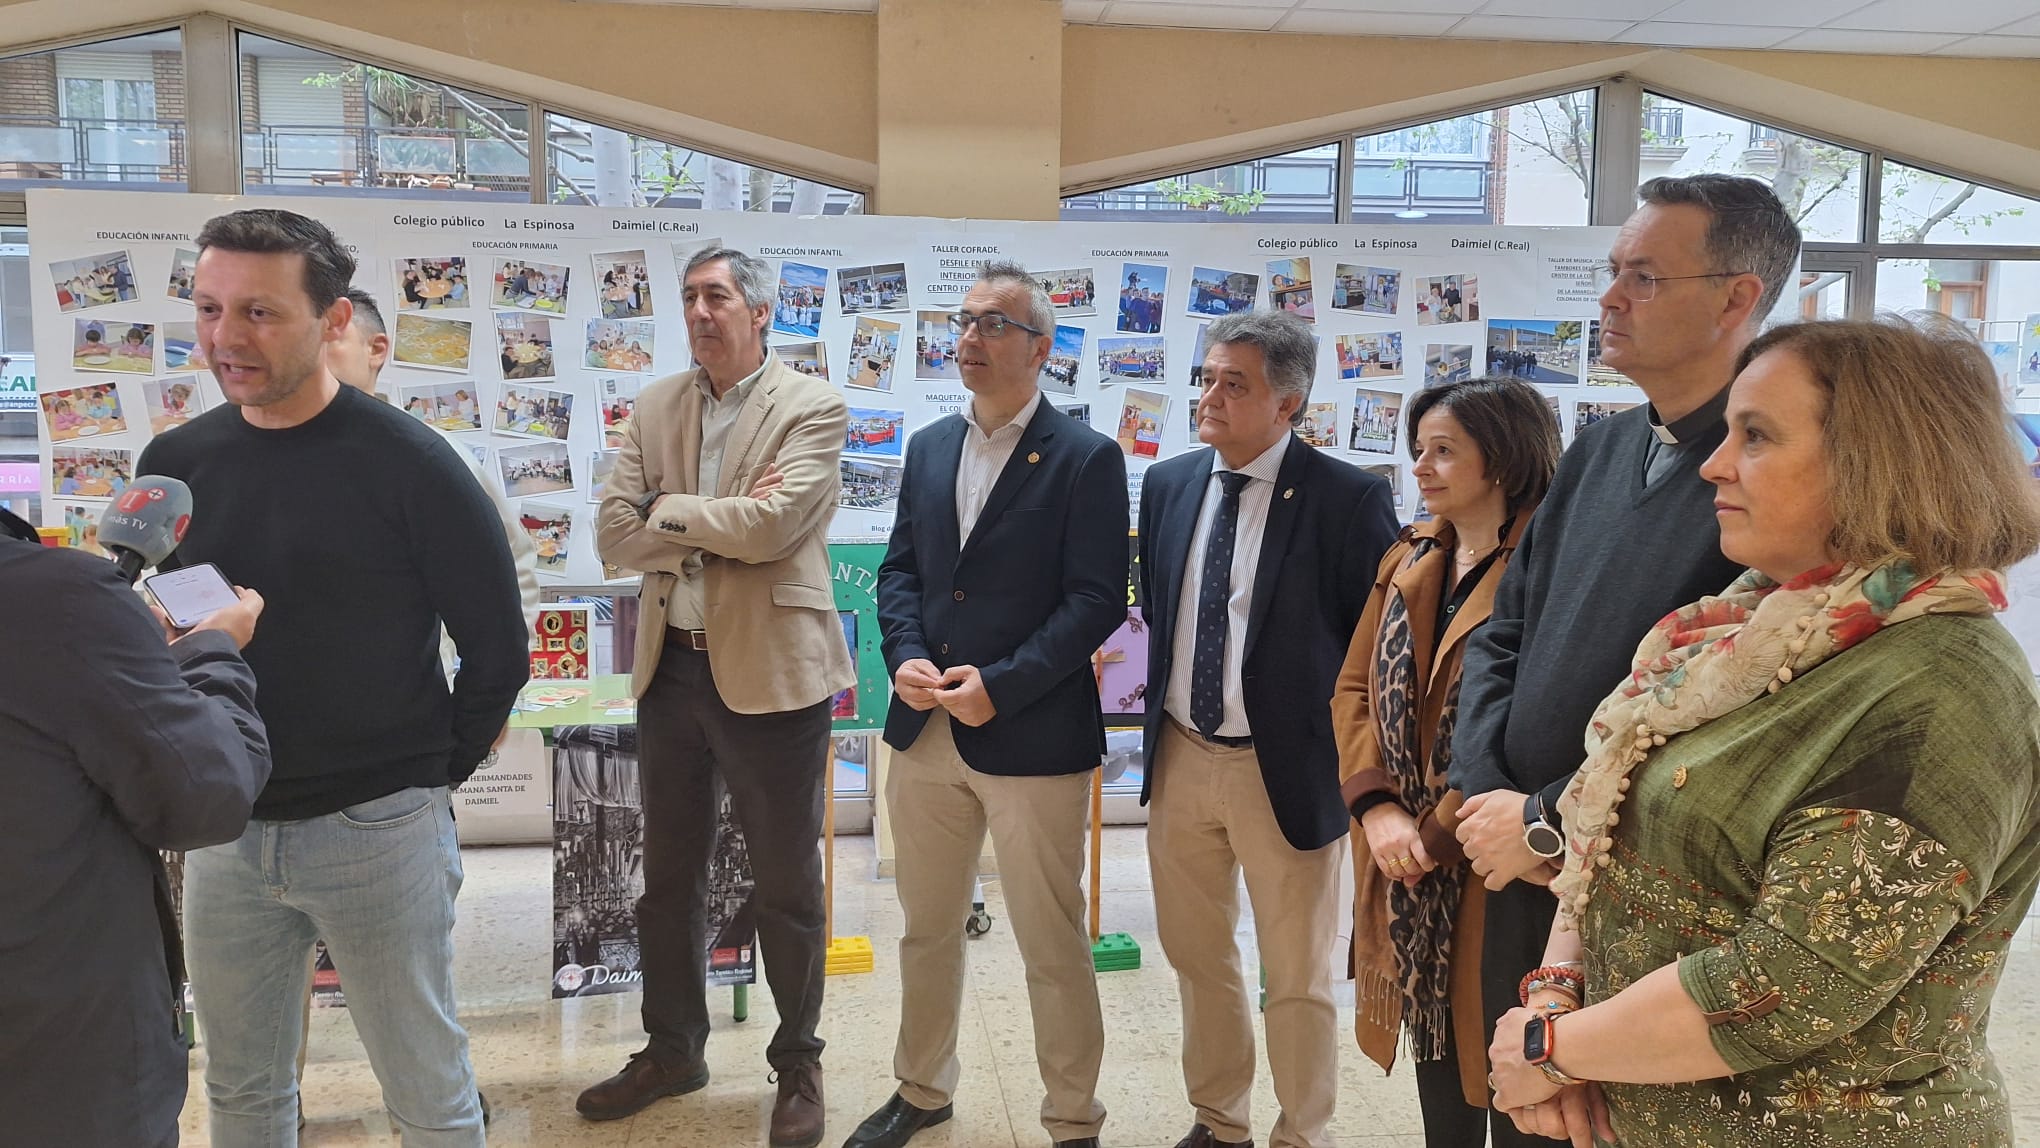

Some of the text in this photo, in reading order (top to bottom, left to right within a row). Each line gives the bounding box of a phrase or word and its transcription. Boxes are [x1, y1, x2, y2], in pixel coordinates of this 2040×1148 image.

[393, 214, 699, 234] Colegio público La Espinosa Daimiel (C.Real)
[96, 231, 191, 241] EDUCACIÓN INFANTIL
[472, 240, 559, 250] EDUCACIÓN PRIMARIA
[1257, 238, 1530, 252] Colegio público La Espinosa Daimiel (C.Real)
[760, 246, 843, 256] EDUCACIÓN INFANTIL
[931, 245, 1001, 255] TALLER COFRADE,
[1091, 249, 1133, 257] EDUCACIÓN
[940, 259, 969, 267] DESFILE
[971, 259, 981, 267] EN
[940, 271, 976, 280] INTERIOR
[927, 284, 959, 292] CENTRO
[131, 518, 148, 531] TV
[470, 773, 533, 782] HERMANDADES
[454, 786, 485, 794] EMANA
[486, 785, 513, 793] SANTA
[465, 797, 500, 806] DAIMIEL
